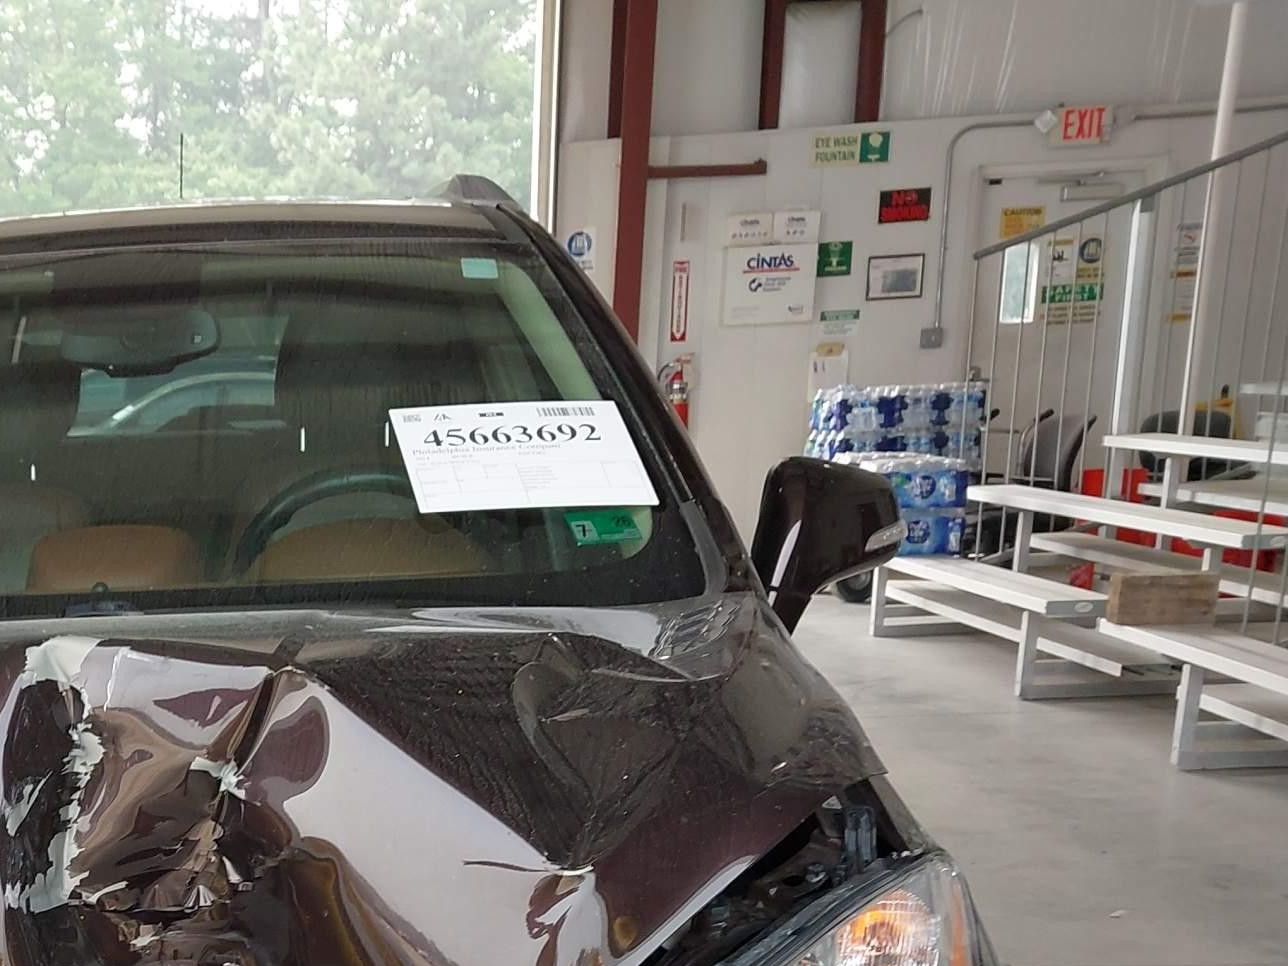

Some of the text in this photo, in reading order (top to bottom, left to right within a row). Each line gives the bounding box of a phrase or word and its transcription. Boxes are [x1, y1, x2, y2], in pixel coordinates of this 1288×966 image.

[1063, 106, 1106, 140] EXIT
[833, 135, 858, 149] WASH
[815, 149, 856, 162] FOUNTAIN
[1004, 207, 1043, 217] CAUTION
[746, 252, 794, 270] CINTAS
[423, 423, 602, 447] 45663692
